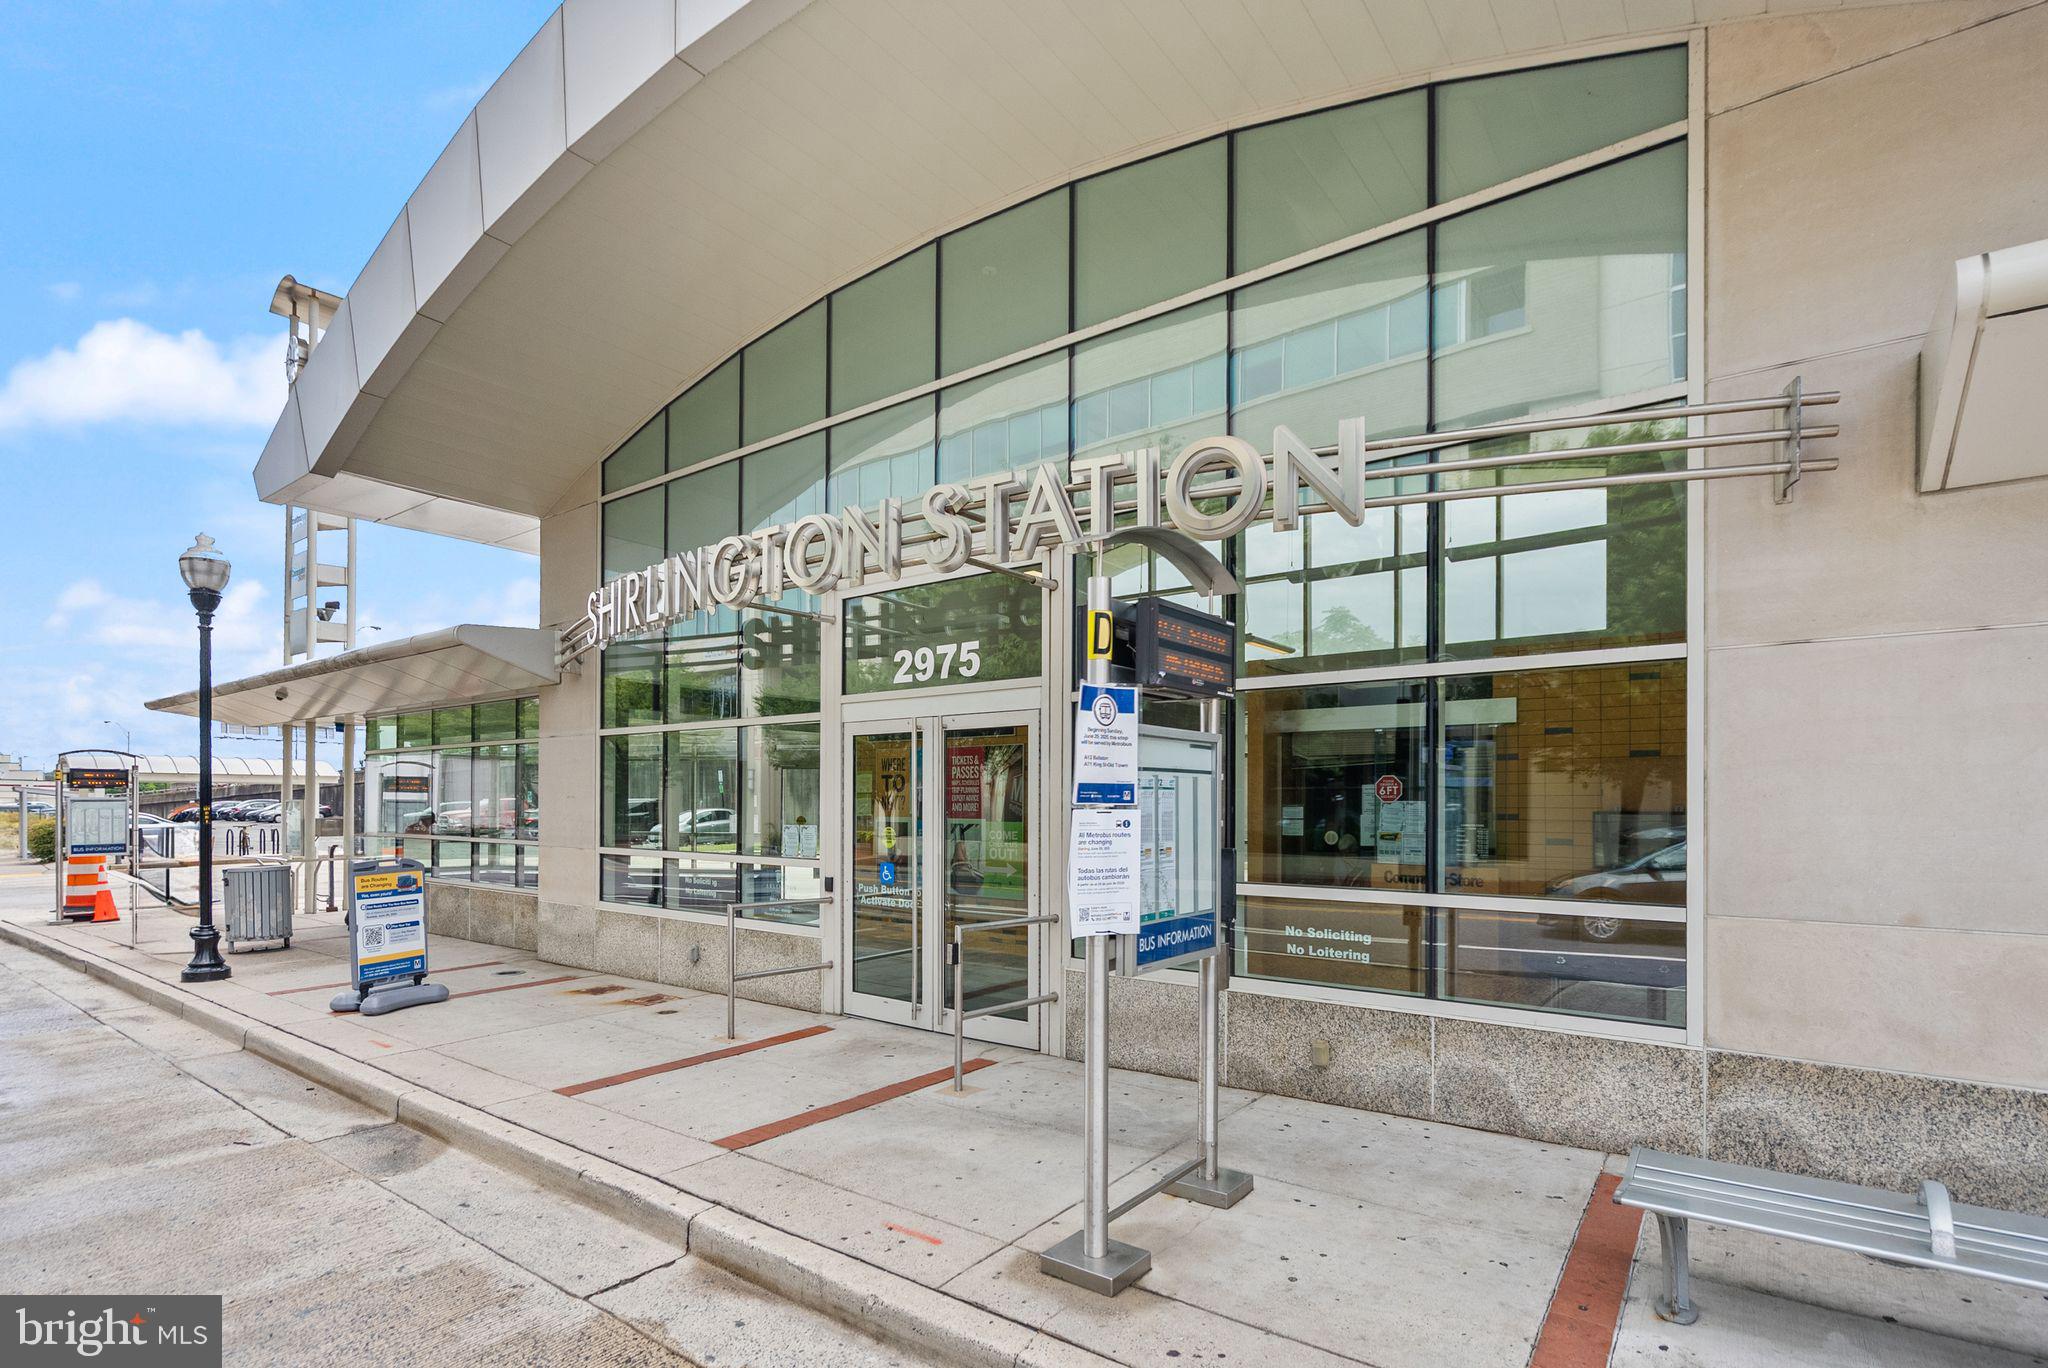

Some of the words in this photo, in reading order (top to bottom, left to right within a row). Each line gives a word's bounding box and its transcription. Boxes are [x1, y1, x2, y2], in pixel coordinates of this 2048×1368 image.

[586, 496, 902, 649] SHIRLINGTON
[922, 416, 1365, 573] STATION
[1094, 612, 1111, 654] D
[893, 641, 981, 684] 2975
[881, 757, 906, 772] WHERE
[952, 756, 973, 765] TICKETS
[952, 767, 979, 779] PASSES
[881, 774, 906, 792] TO
[952, 803, 962, 812] AND
[990, 831, 1018, 840] COME
[1088, 838, 1112, 846] changing
[1450, 873, 1484, 888] Store
[858, 883, 878, 894] Push
[881, 884, 910, 896] Button
[860, 896, 896, 907] Activate
[1139, 934, 1156, 952] BUS
[1158, 924, 1212, 948] INFORMATION
[1285, 926, 1304, 938] No
[1308, 926, 1372, 945] Soliciting
[1287, 944, 1305, 956] No
[1309, 946, 1370, 964] Loitering
